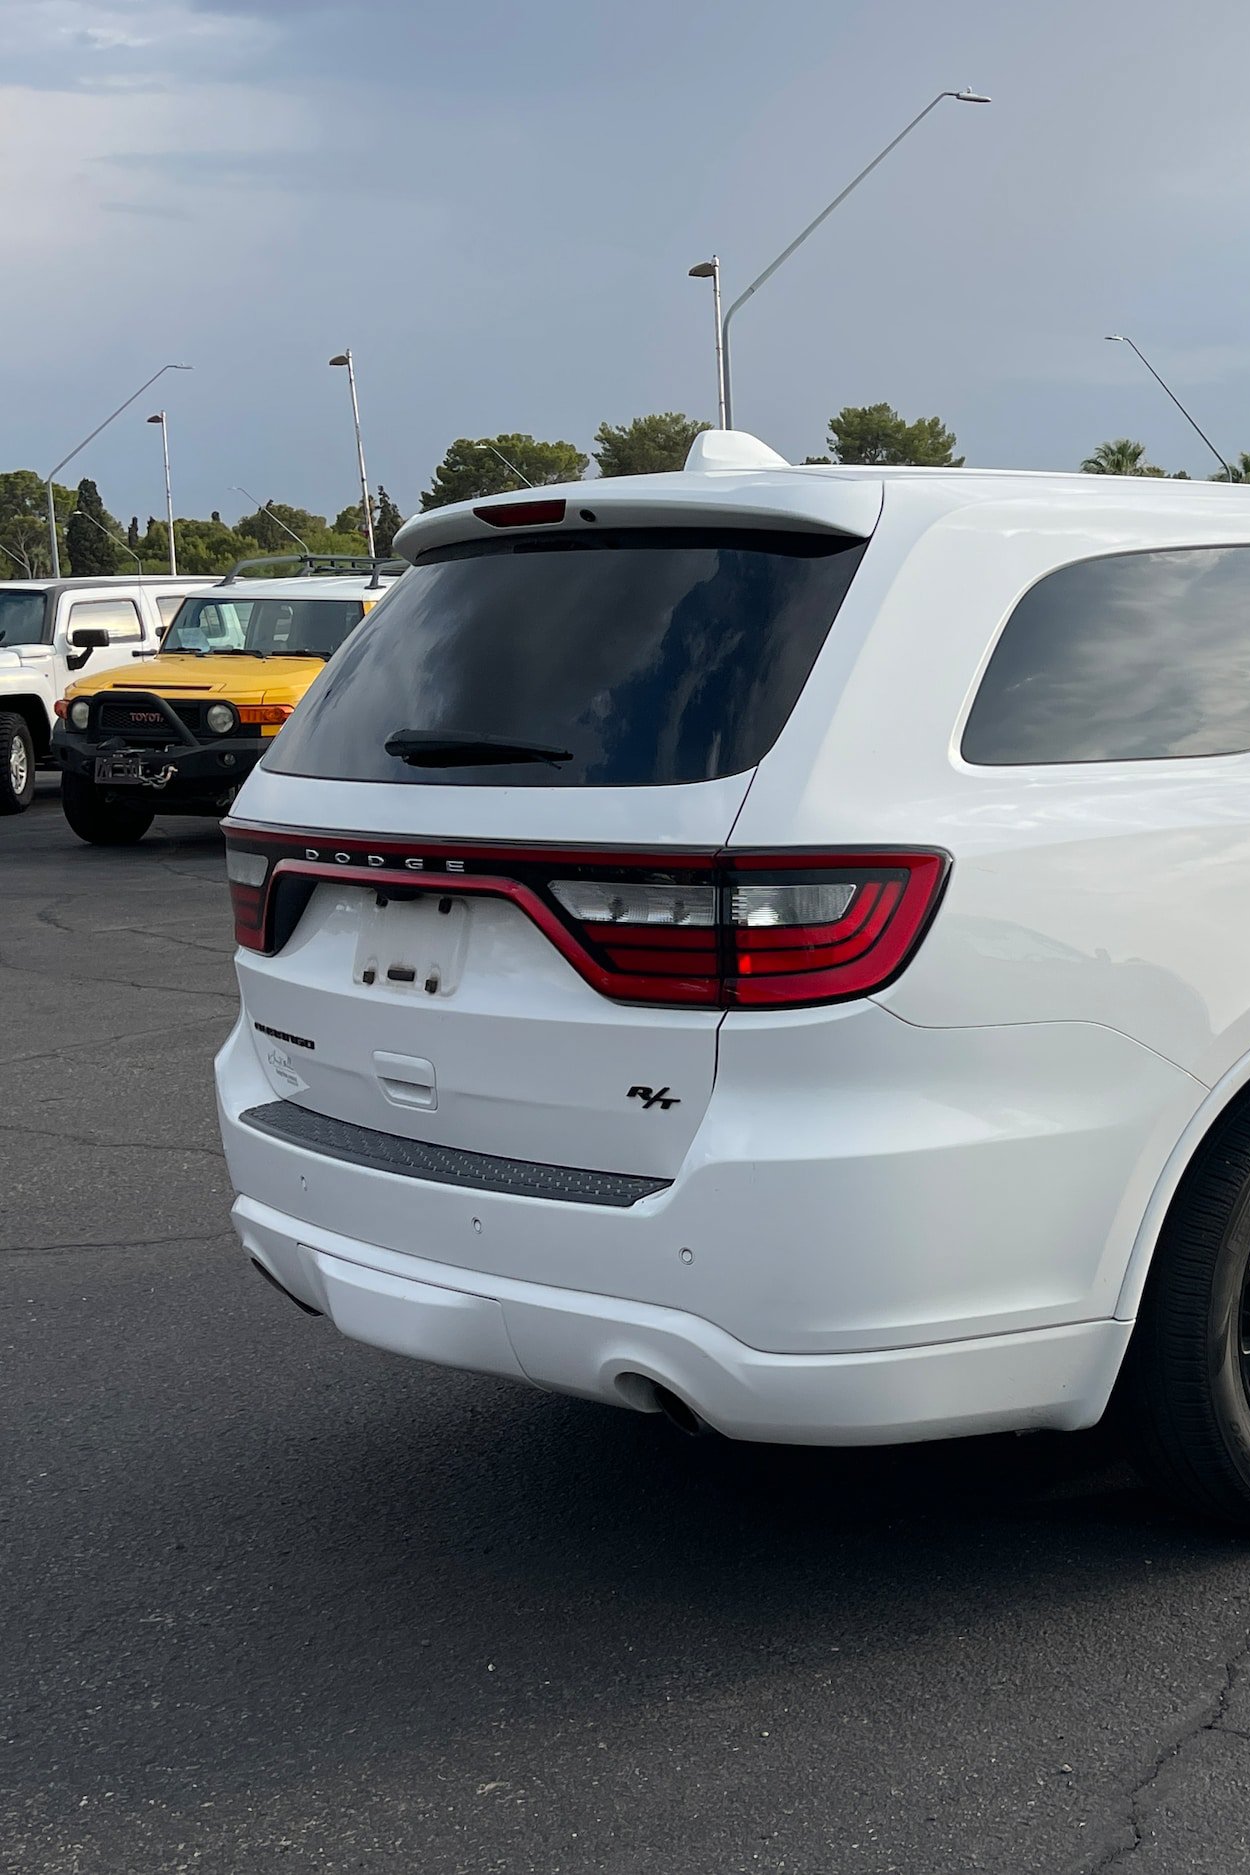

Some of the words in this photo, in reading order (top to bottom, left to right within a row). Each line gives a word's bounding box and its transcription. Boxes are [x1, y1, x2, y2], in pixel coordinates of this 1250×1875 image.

[130, 712, 164, 722] TOYOT
[305, 848, 465, 873] DODGE
[626, 1086, 682, 1110] R/T
